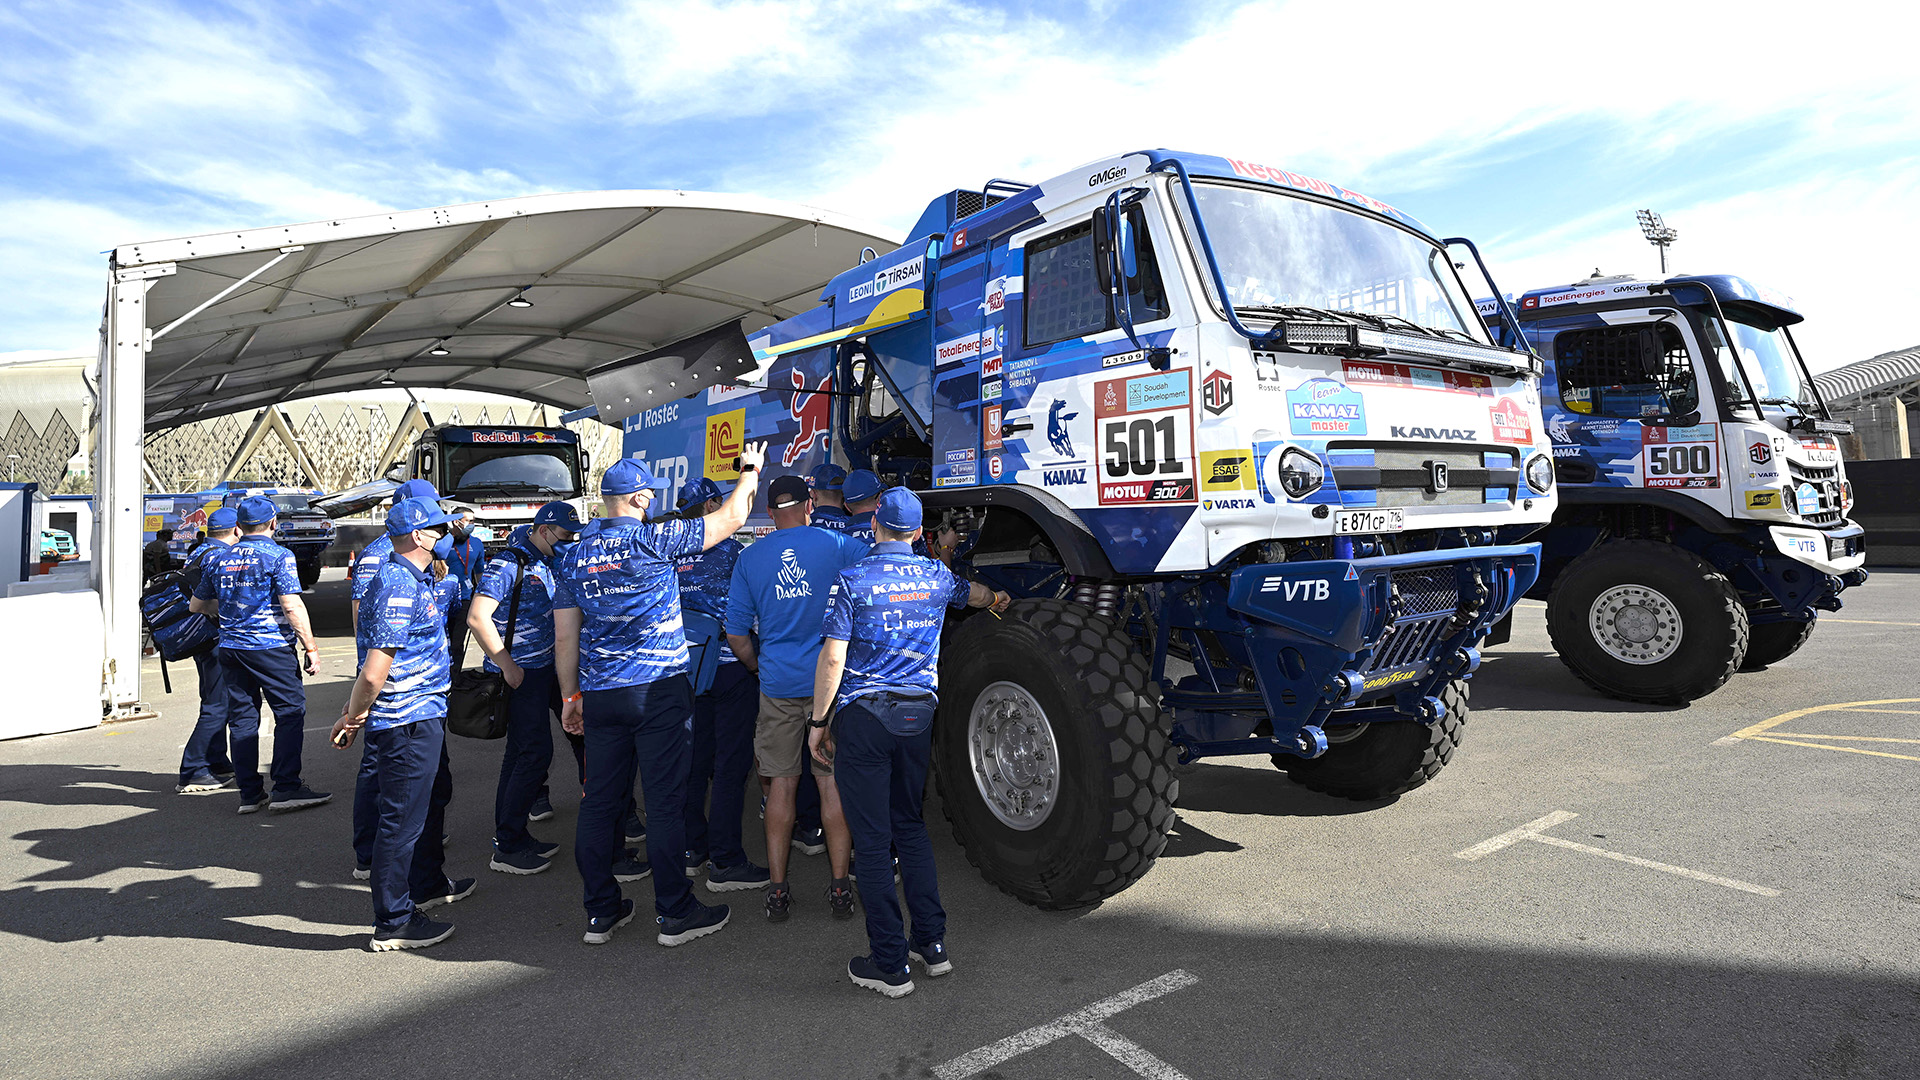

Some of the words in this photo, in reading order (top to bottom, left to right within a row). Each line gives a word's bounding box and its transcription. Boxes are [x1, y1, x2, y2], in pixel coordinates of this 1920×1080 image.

[850, 282, 872, 300] LEONI
[1543, 289, 1606, 304] TotalEnergies
[938, 336, 992, 359] TotalEnergies
[1009, 359, 1034, 370] TATARINOV
[1104, 352, 1142, 366] 43509
[1009, 370, 1026, 380] NIKITIN
[1348, 366, 1384, 380] MOTUL
[1009, 378, 1032, 389] SHIBALOV
[1144, 382, 1168, 392] Soudah
[1258, 384, 1281, 392] Rostec
[1144, 390, 1186, 402] Development
[1308, 381, 1340, 400] Team
[644, 404, 679, 428] Rostec
[1292, 403, 1360, 420] KAMAZ
[1311, 420, 1349, 431] master
[472, 432, 496, 442] Red
[498, 432, 520, 442] Bull
[1391, 426, 1476, 441] KAMAZ
[1106, 416, 1184, 477] 501
[948, 452, 965, 461] РОССИЯ
[1650, 446, 1710, 475] 500
[715, 462, 734, 474] COMPAN
[1213, 465, 1240, 476] ESAB
[1044, 468, 1087, 486] KAMAZ
[1103, 483, 1146, 499] MOTUL
[1153, 484, 1190, 499] 300V
[1214, 499, 1256, 510] VARTA
[1351, 512, 1371, 531] 871
[1390, 512, 1402, 522] 716
[824, 520, 846, 528] VTB
[602, 538, 622, 550] VTB
[1798, 541, 1816, 552] VTB
[239, 547, 255, 555] VTB
[220, 558, 259, 566] KAMAZ
[577, 550, 631, 568] KAMAZ
[588, 562, 622, 574] master
[895, 564, 924, 576] VTB
[604, 584, 636, 595] Rostec
[680, 584, 702, 593] Rostec
[775, 580, 812, 600] DAKAR
[872, 581, 940, 594] KAMAZ
[1283, 579, 1330, 601] VTB
[889, 592, 931, 602] master
[906, 619, 936, 628] Rostec
[1363, 670, 1416, 689] GOODYEAR
